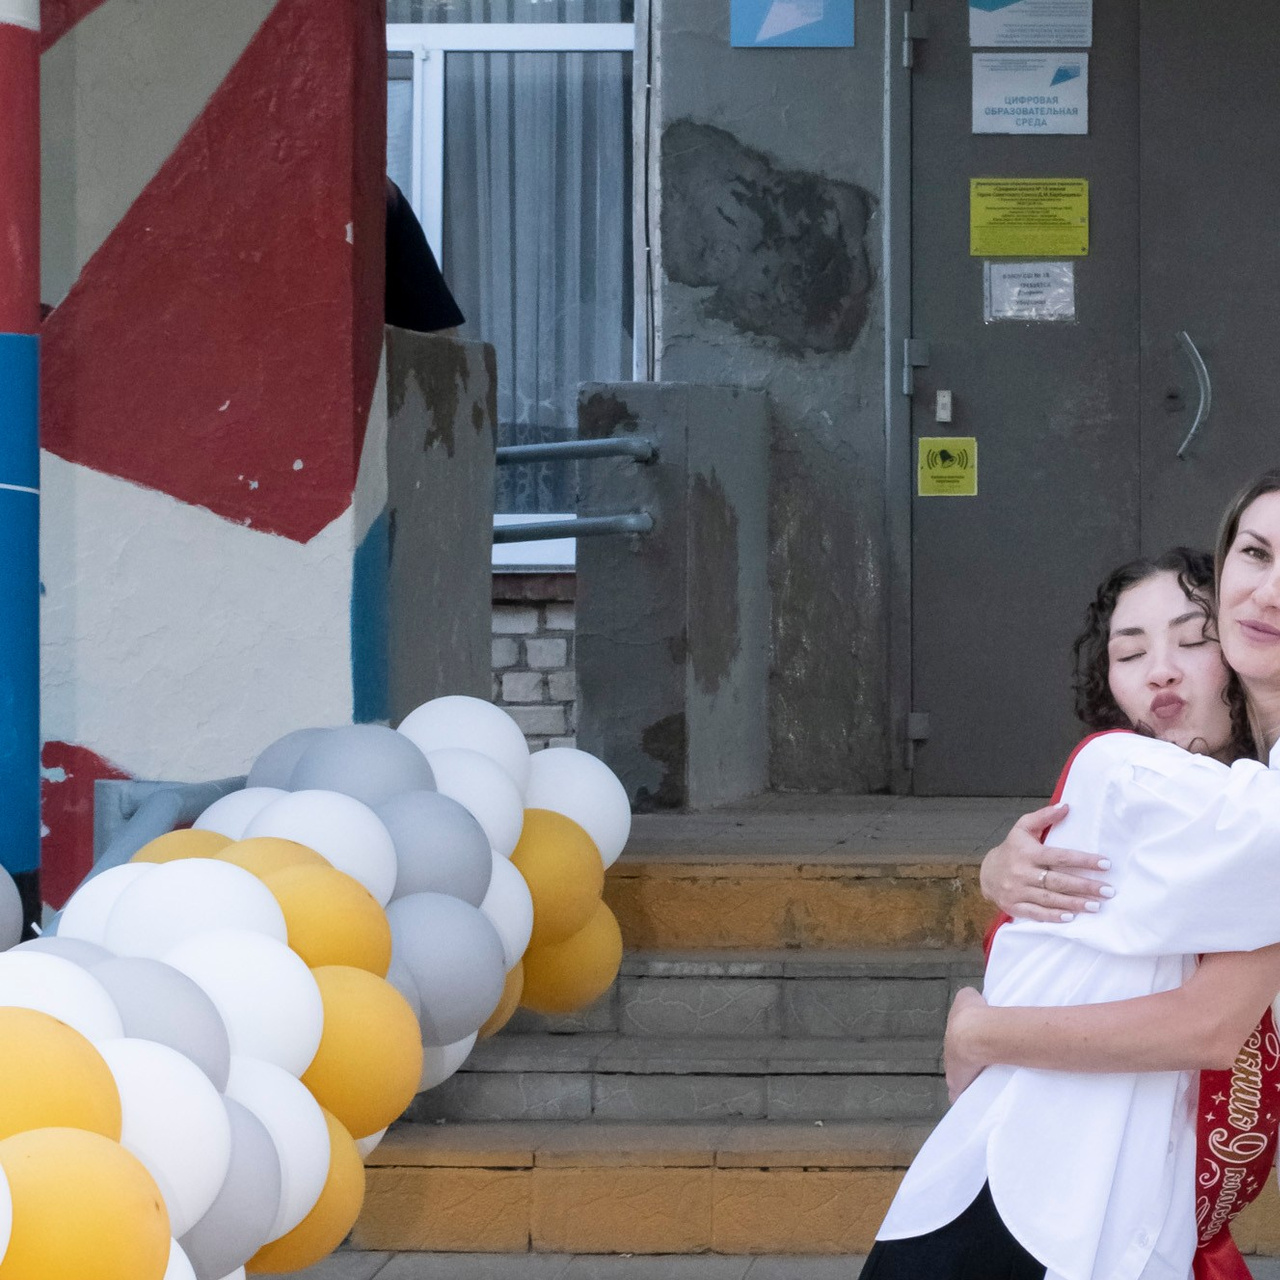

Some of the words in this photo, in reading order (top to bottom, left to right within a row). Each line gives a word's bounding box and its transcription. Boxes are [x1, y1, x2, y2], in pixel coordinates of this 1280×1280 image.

[1004, 95, 1059, 105] ЦИФРОВАЯ
[984, 107, 1079, 116] ОБРАЗОВАТЕЛЬНАЯ
[1015, 118, 1048, 127] СРЕДА
[1208, 1127, 1267, 1164] 9
